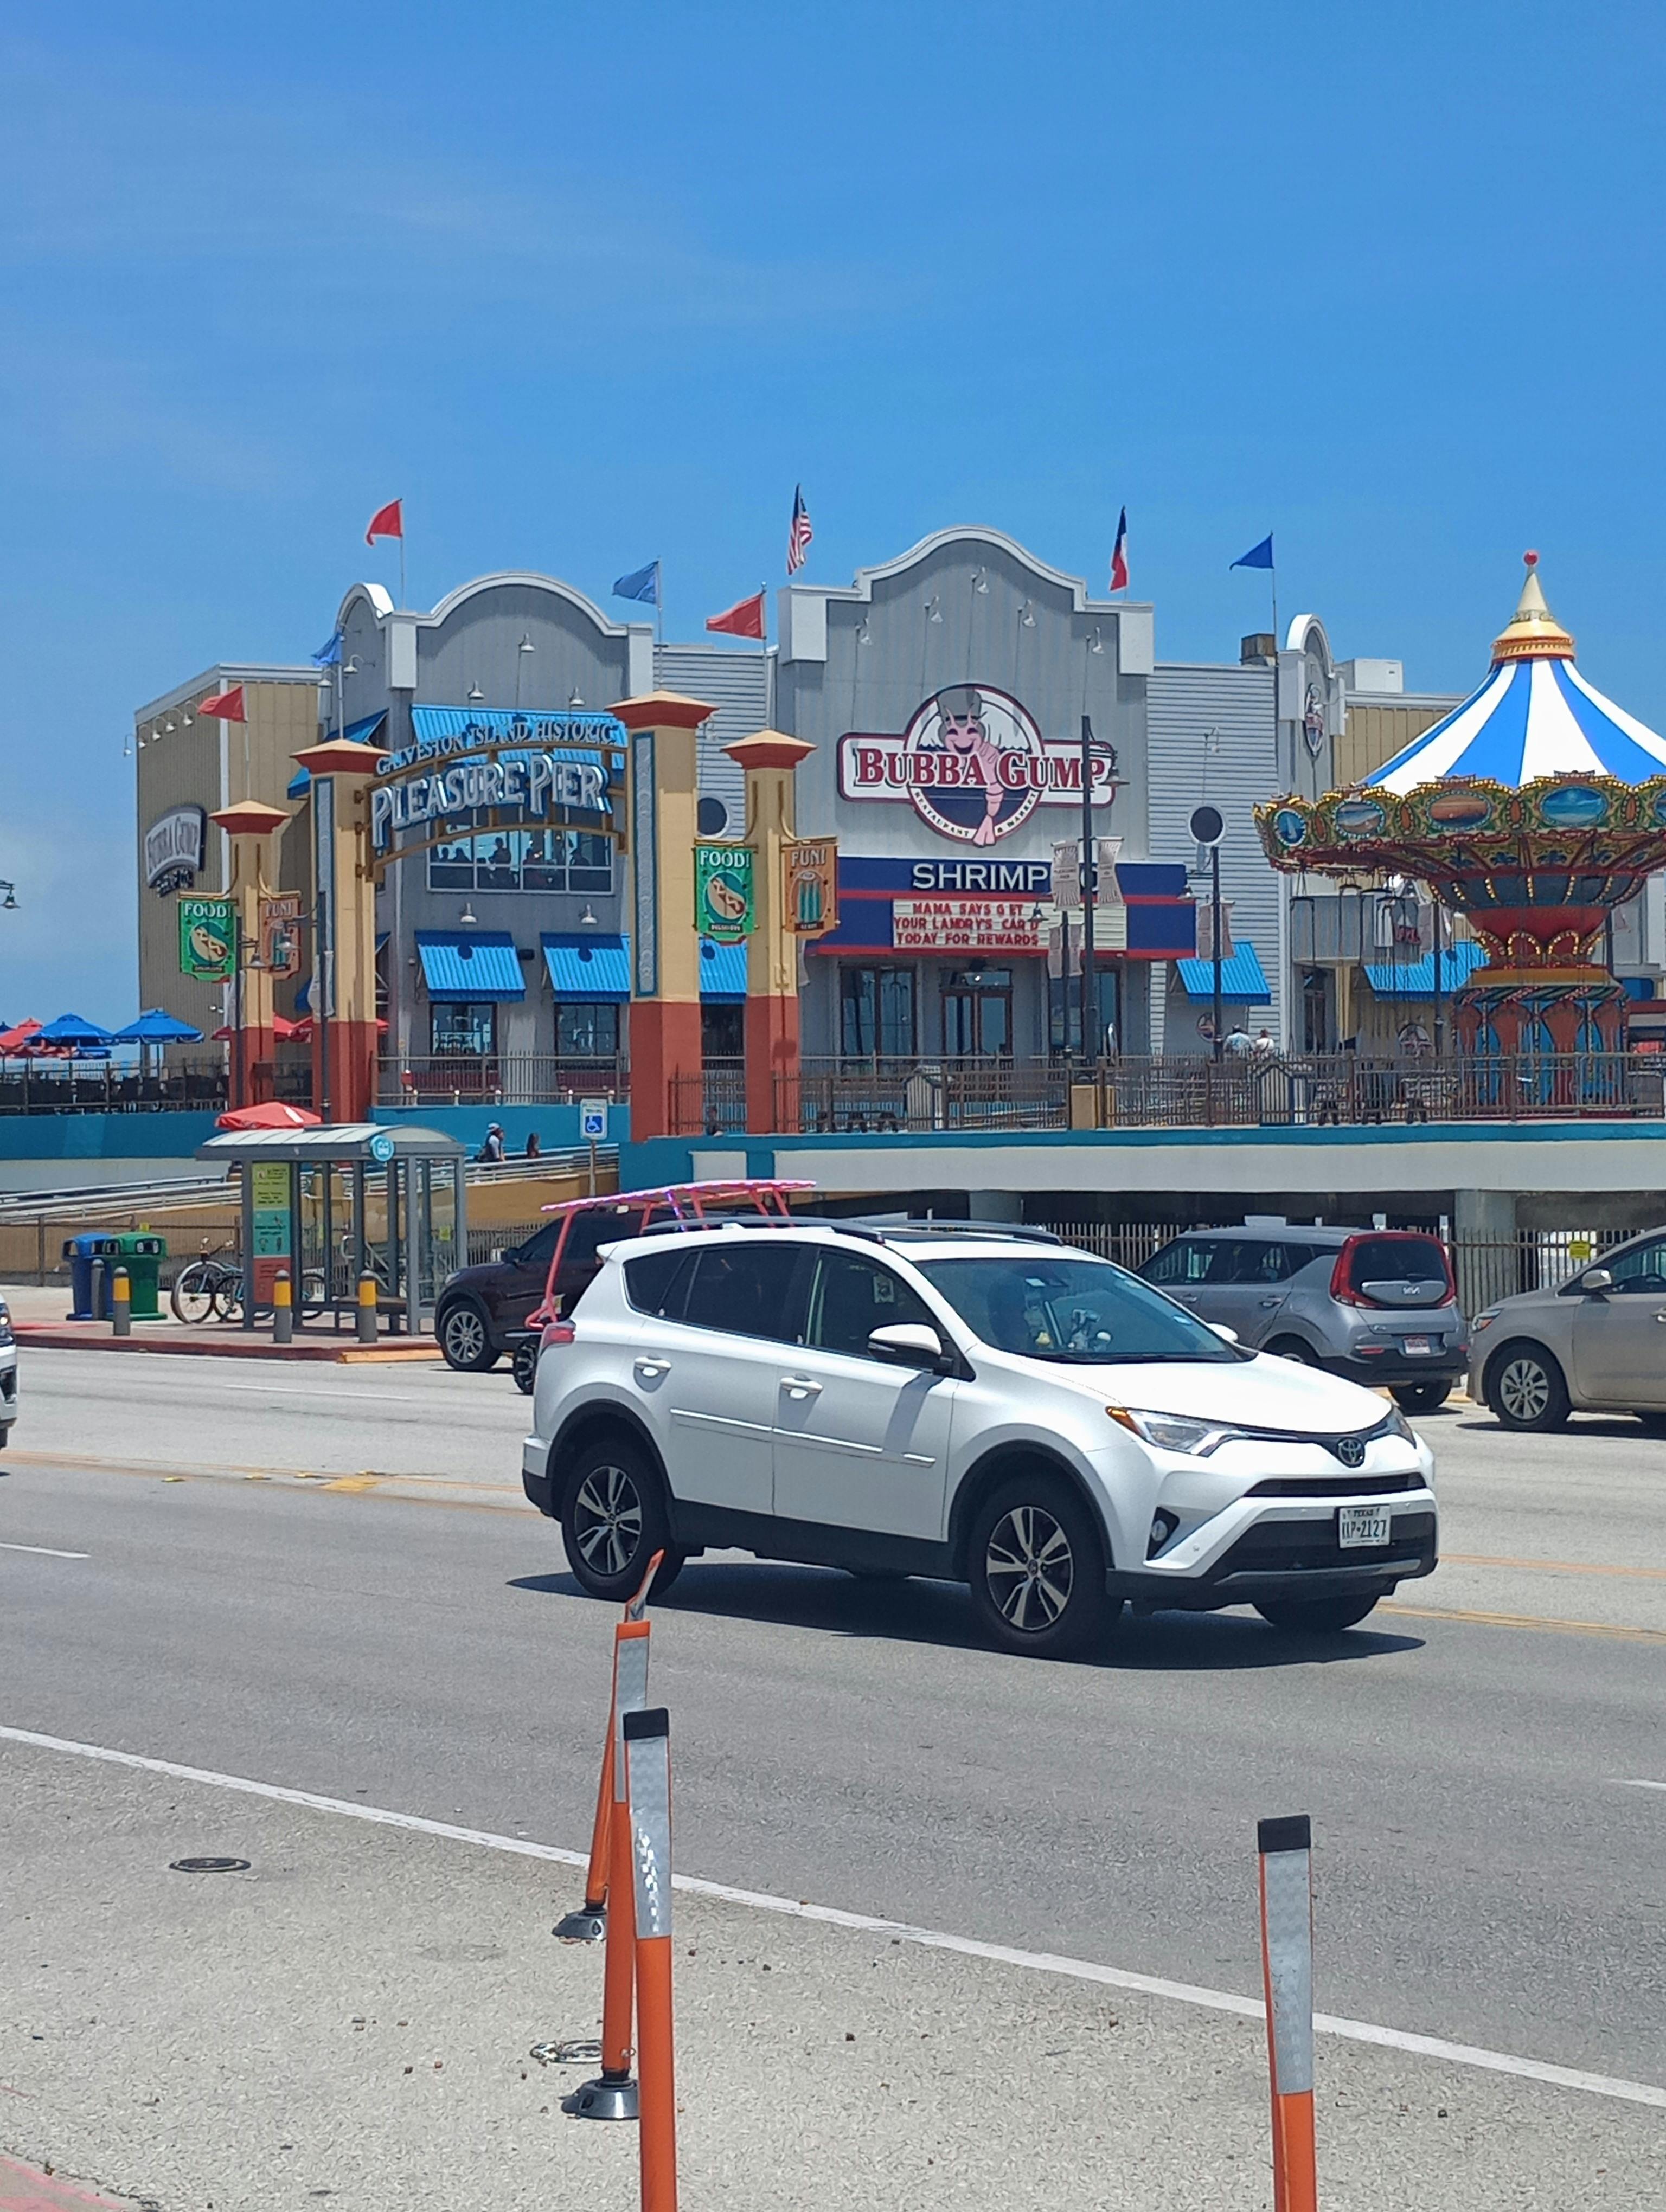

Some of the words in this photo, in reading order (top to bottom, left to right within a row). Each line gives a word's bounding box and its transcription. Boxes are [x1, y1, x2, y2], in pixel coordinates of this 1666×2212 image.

[376, 734, 464, 775] GALVESTON
[469, 723, 528, 748] ISLAND
[532, 721, 616, 744] HISTORIC
[855, 748, 988, 787] BUBBA
[998, 751, 1105, 790] GUMP
[370, 761, 526, 848] PLEASURE
[529, 753, 612, 815] PIER
[700, 850, 750, 868] FOOD!
[791, 848, 826, 867] FUN!
[913, 863, 1049, 891] SHRIMP
[184, 902, 232, 918] FOOD!
[912, 903, 952, 916] MAMA
[959, 903, 992, 915] SAYS
[894, 917, 927, 929] YOUR
[896, 932, 938, 945] TODAY
[945, 933, 970, 946] FOR
[977, 933, 1040, 947] REWARDS
